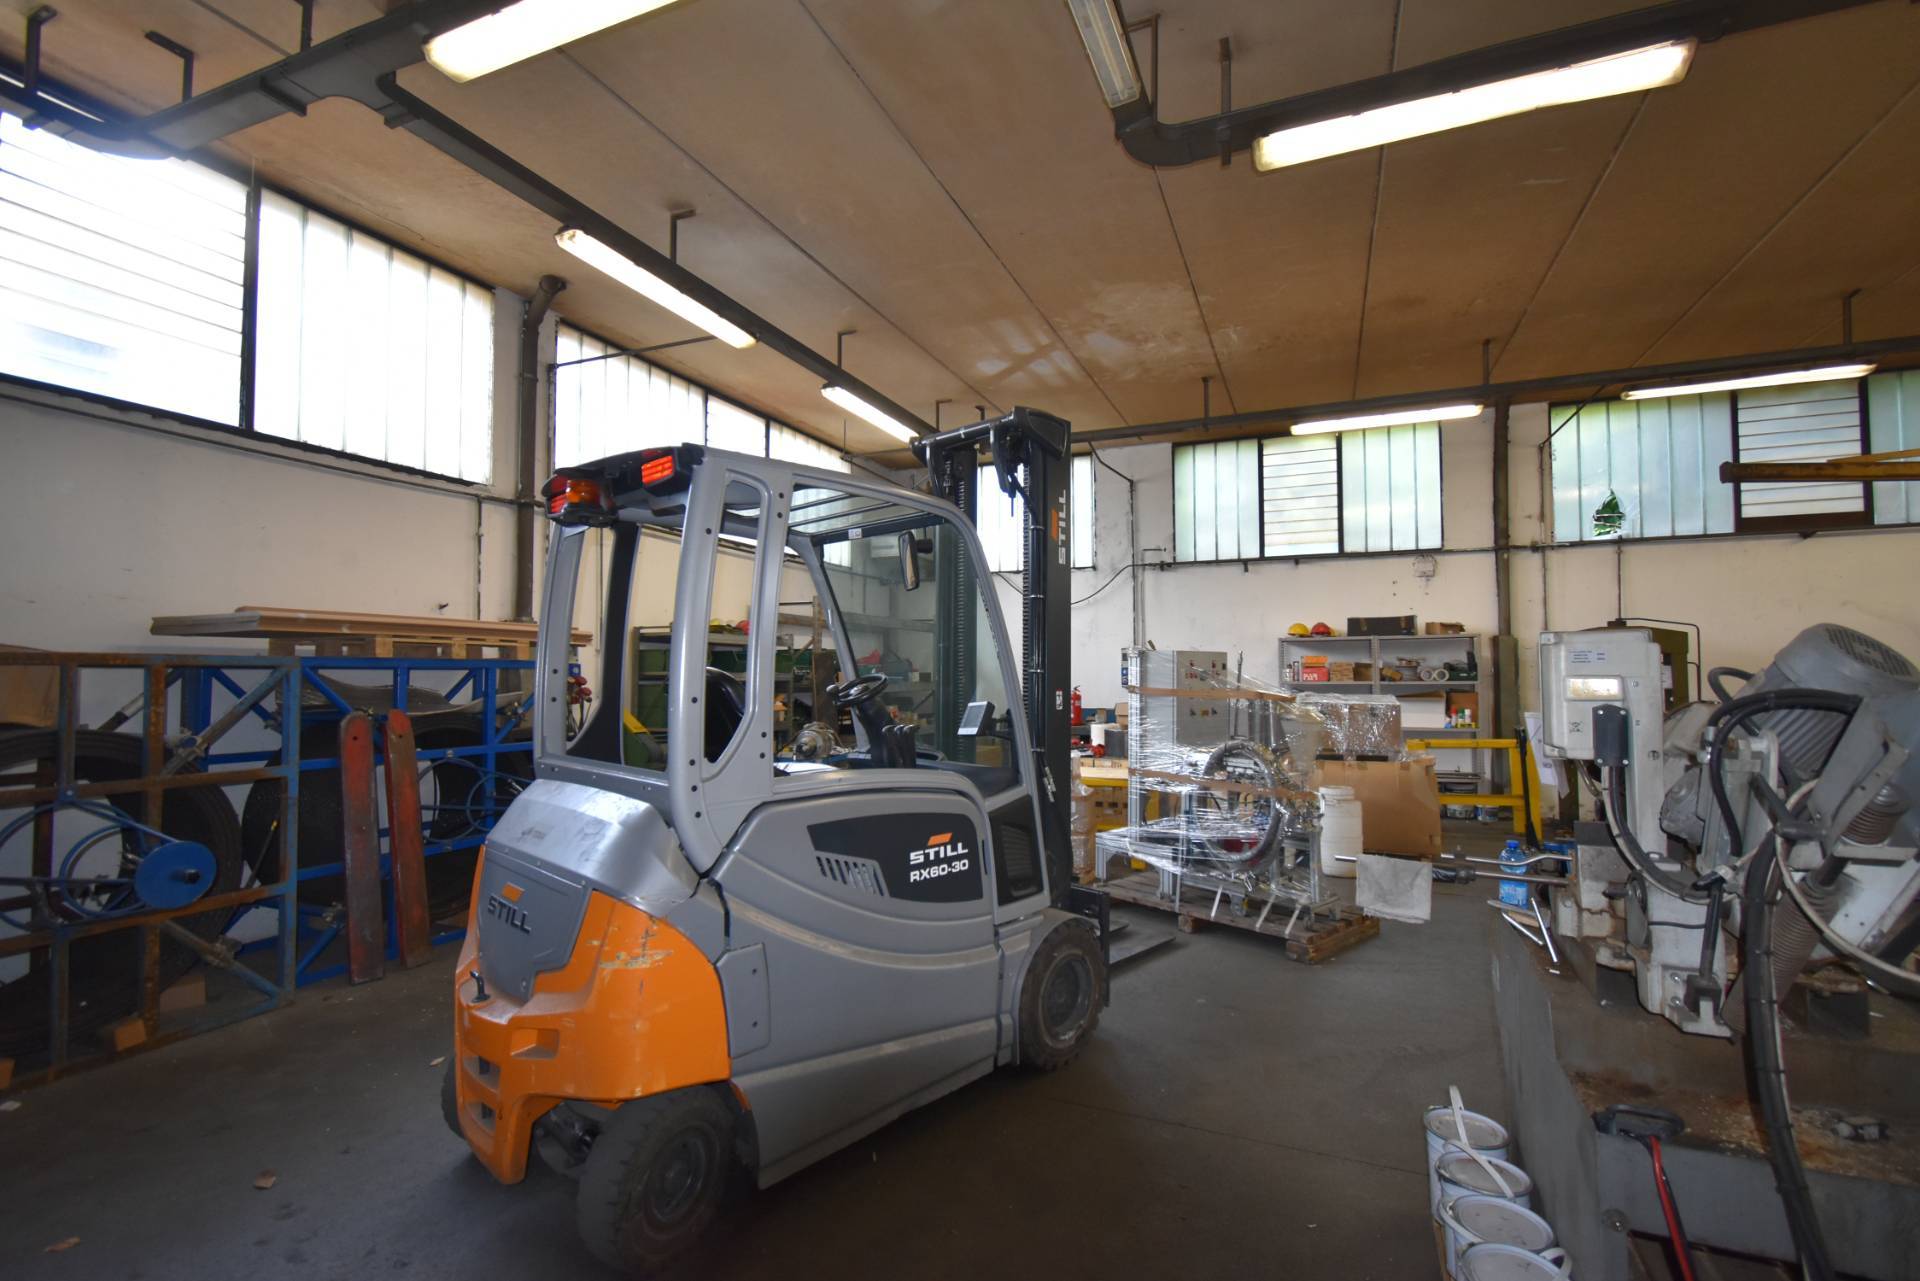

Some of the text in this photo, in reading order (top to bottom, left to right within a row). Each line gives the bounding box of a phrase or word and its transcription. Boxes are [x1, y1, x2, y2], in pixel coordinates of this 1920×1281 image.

[1058, 489, 1066, 565] STILL
[909, 842, 969, 865] STILL
[909, 859, 969, 883] RX60-30
[487, 894, 531, 934] STILL
